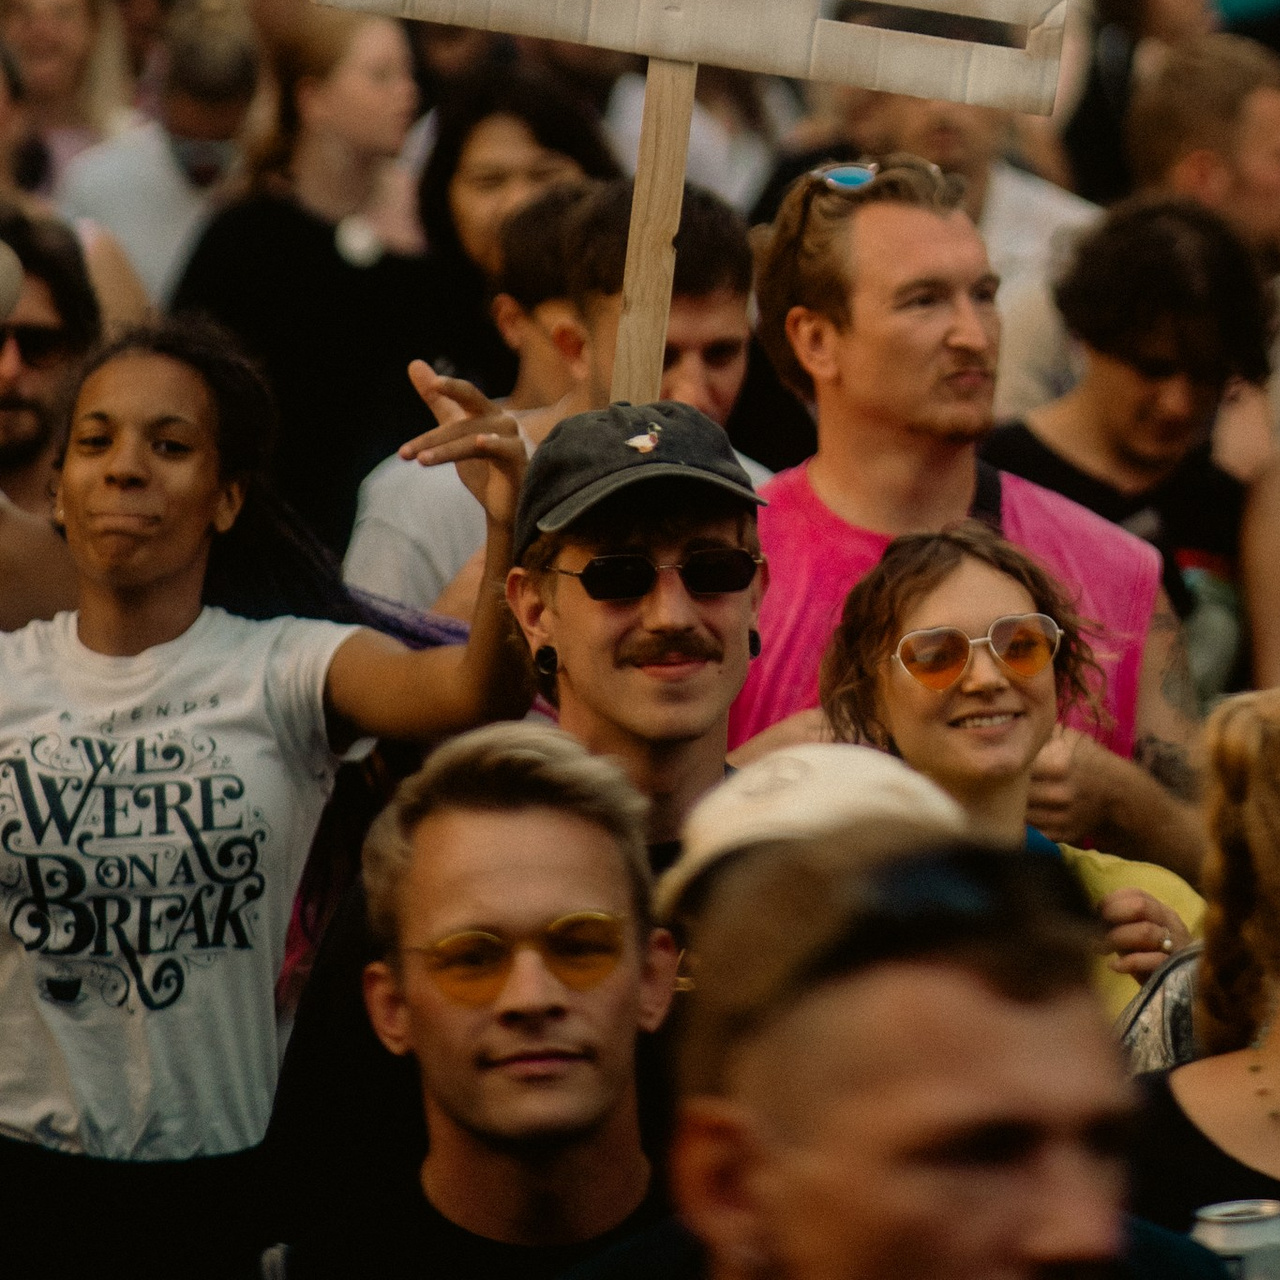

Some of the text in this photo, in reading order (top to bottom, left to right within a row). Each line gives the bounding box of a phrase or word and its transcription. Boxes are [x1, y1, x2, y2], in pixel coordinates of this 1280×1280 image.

[58, 693, 220, 724] IENDS
[70, 735, 186, 774] WE
[0, 757, 252, 858] WERE
[95, 849, 197, 889] ON A
[6, 848, 264, 970] BREAK
